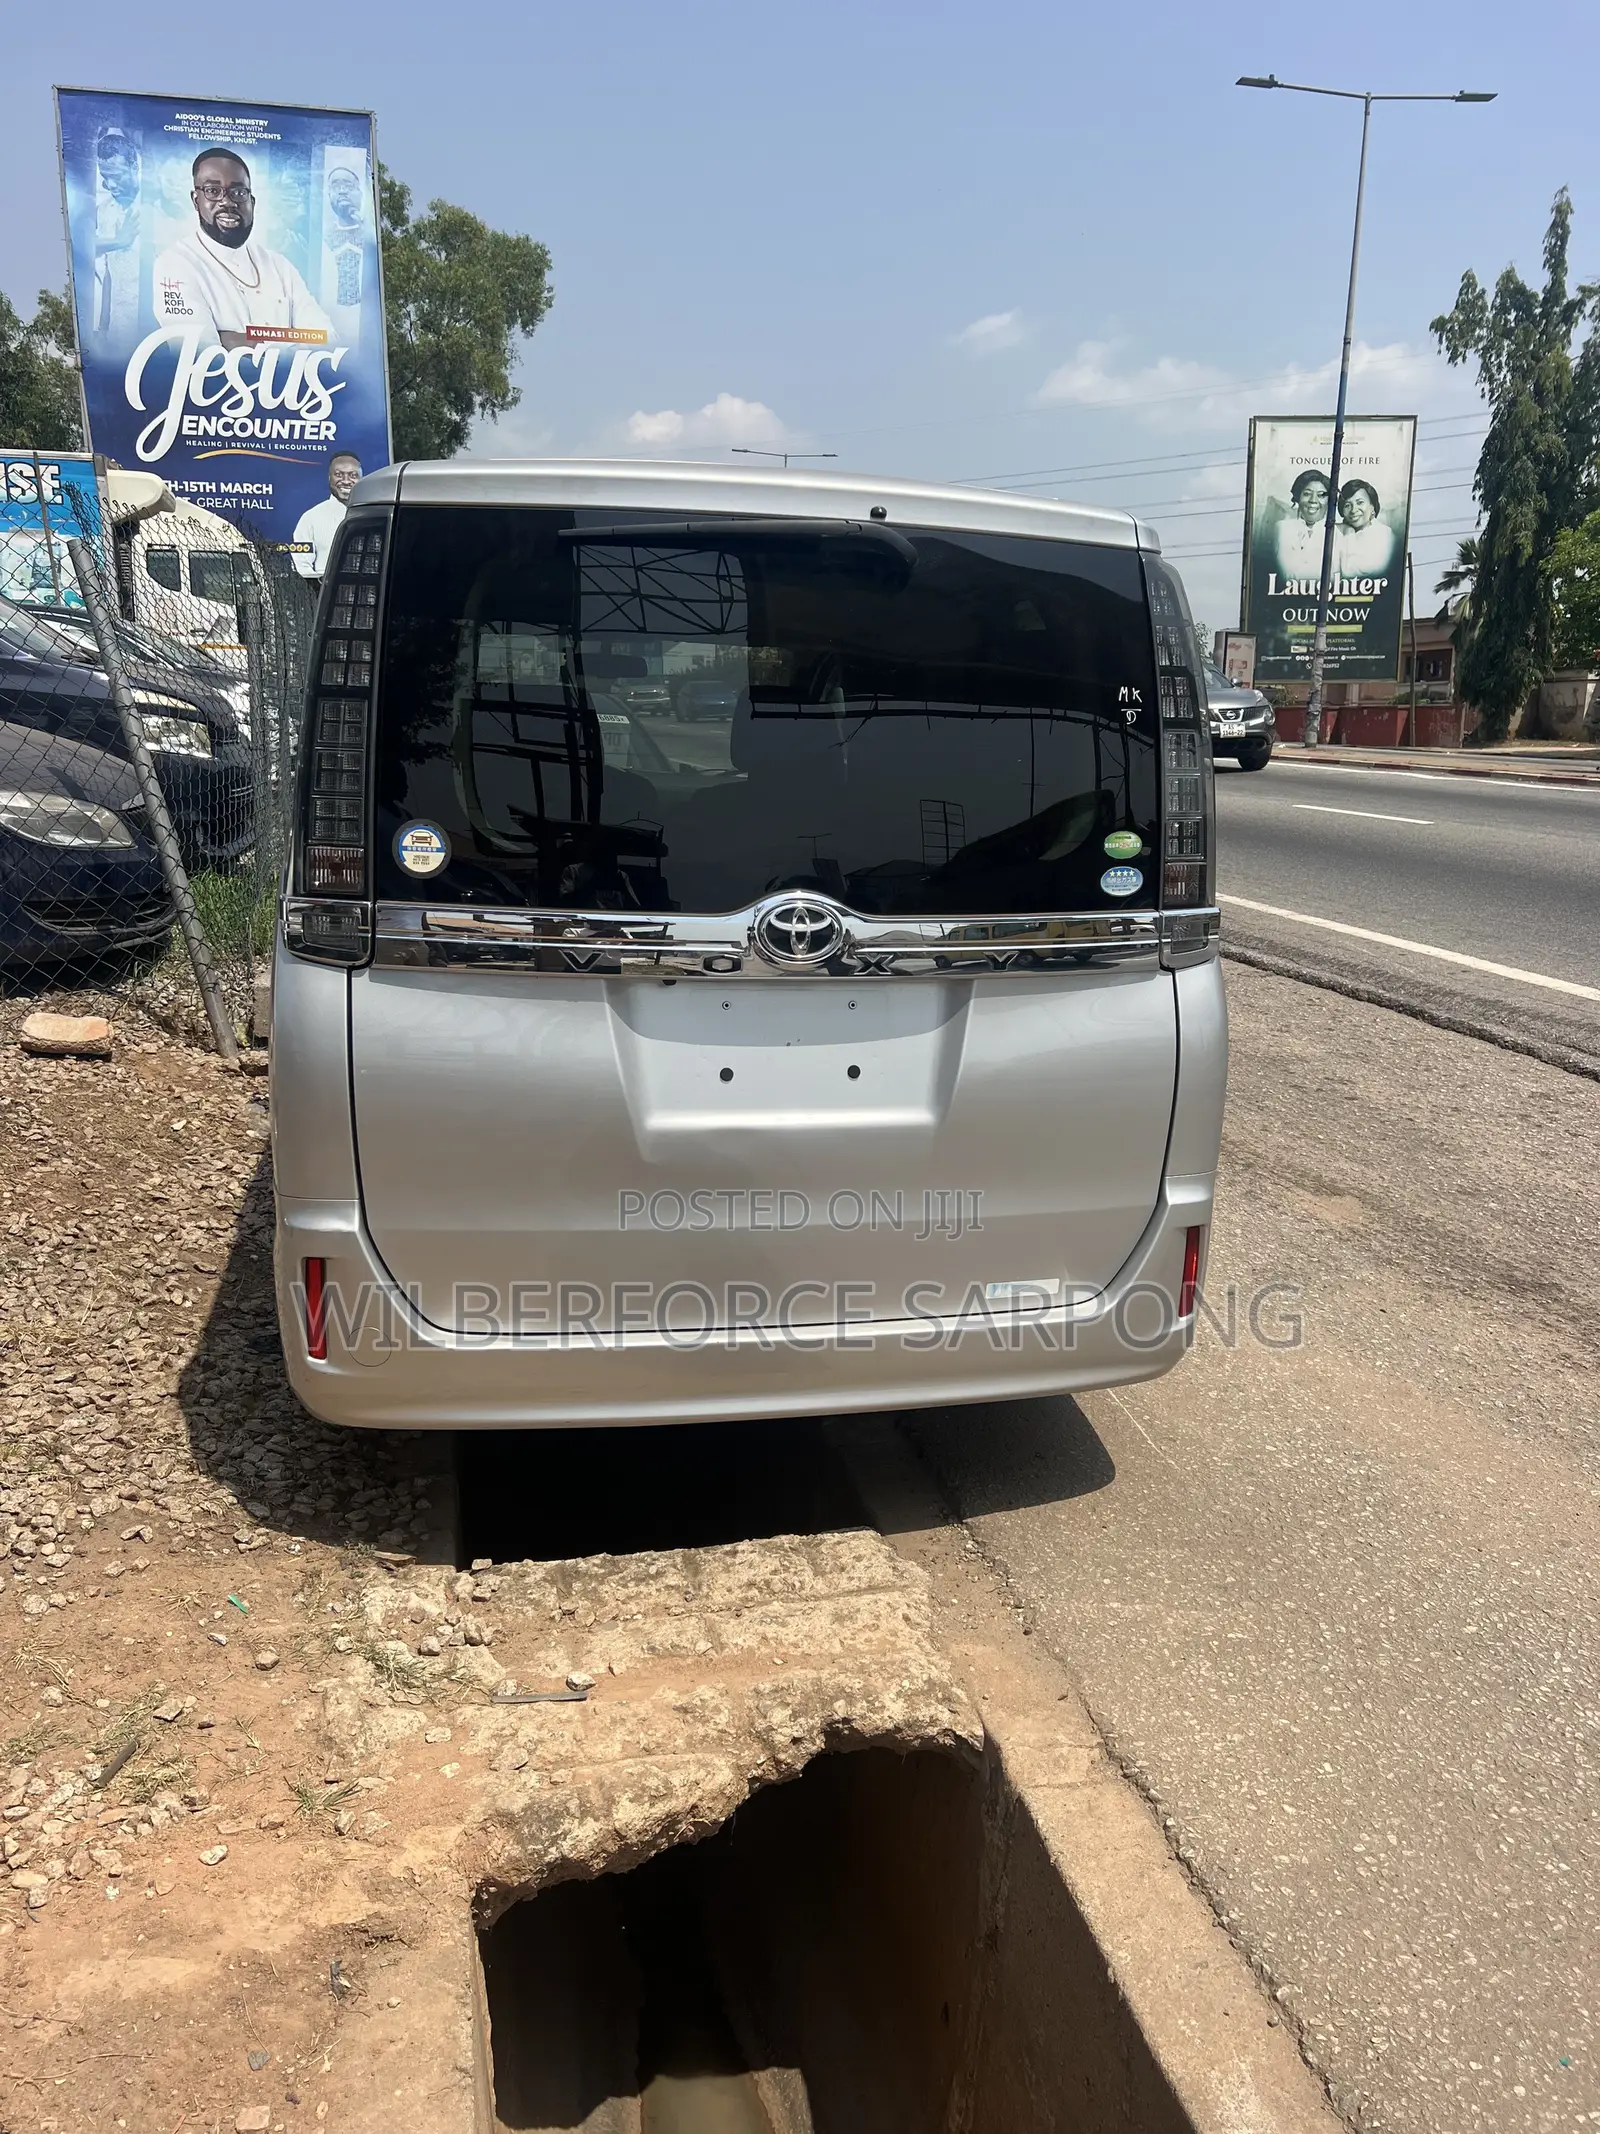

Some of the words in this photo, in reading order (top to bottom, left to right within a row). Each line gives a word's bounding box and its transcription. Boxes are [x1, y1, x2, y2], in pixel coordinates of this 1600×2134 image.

[175, 113, 205, 121] AIDOO'S
[206, 115, 234, 124] GLOBAL
[235, 118, 269, 127] MINISTRY
[189, 121, 245, 131] COLLABORATION
[163, 125, 200, 133] CHRISTIAN
[201, 127, 246, 137] ENGINEERING
[246, 132, 282, 141] STUDENTS
[188, 133, 233, 143] FELLOWSHIP,
[164, 292, 183, 300] REV.
[164, 299, 185, 307] KOFI
[165, 307, 194, 315] AIDOO
[250, 329, 285, 339] KUMASI
[288, 331, 324, 340] EDITION
[124, 324, 349, 462] Jesus
[181, 415, 337, 441] ENCOUNTER
[186, 439, 222, 448] HEALING
[231, 441, 265, 449] REVIVAL
[274, 444, 328, 452] ENCOUNTERS
[1290, 457, 1332, 465] TONGUE
[1341, 456, 1355, 465] OF
[1358, 456, 1380, 465] FIRE
[220, 482, 273, 495] MARCH
[196, 497, 238, 509] GREAT
[241, 498, 274, 510] HALL
[1282, 608, 1318, 622] OUT
[1326, 607, 1371, 622] NOW
[1118, 686, 1143, 703] MK
[558, 948, 1020, 976] VOXY
